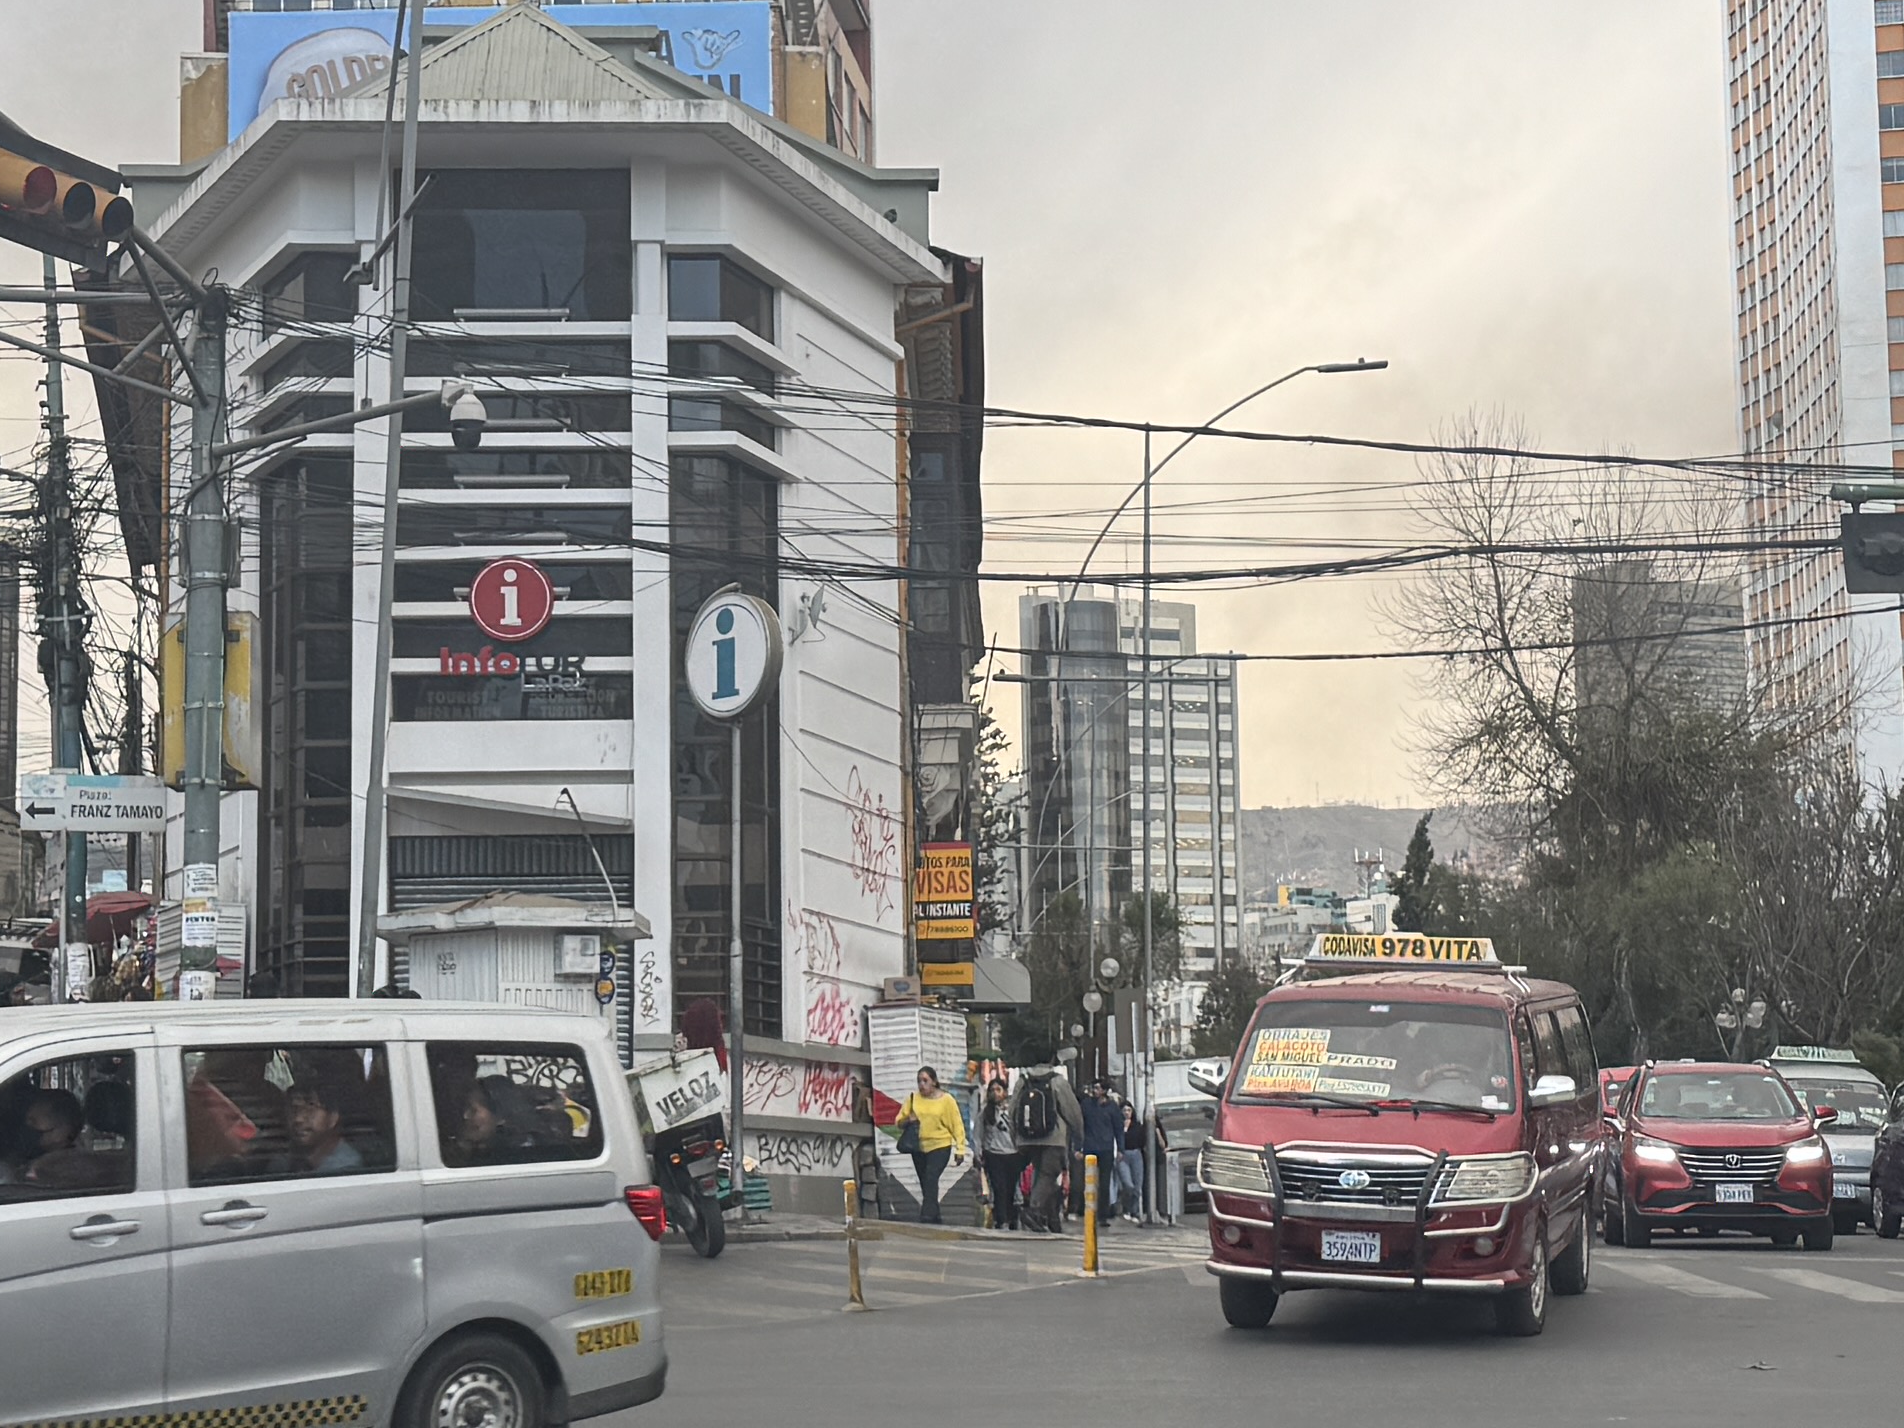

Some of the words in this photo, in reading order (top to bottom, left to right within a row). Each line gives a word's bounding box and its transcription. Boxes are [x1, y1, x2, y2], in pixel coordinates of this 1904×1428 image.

[70, 804, 112, 818] FRANZ
[114, 804, 163, 819] TAMAYO
[916, 869, 971, 895] VISAS
[926, 902, 972, 917] INSTANTE
[1323, 936, 1377, 957] CODAVISA
[1381, 937, 1426, 959] 978
[1429, 938, 1482, 961] VITA
[1262, 1029, 1328, 1041] OBRAJES
[1259, 1040, 1326, 1052] CALACOTO
[1255, 1052, 1278, 1063] SAN
[1280, 1052, 1323, 1064] MIGUEL
[1327, 1054, 1394, 1068] PRADO
[655, 1070, 718, 1117] VELOZ
